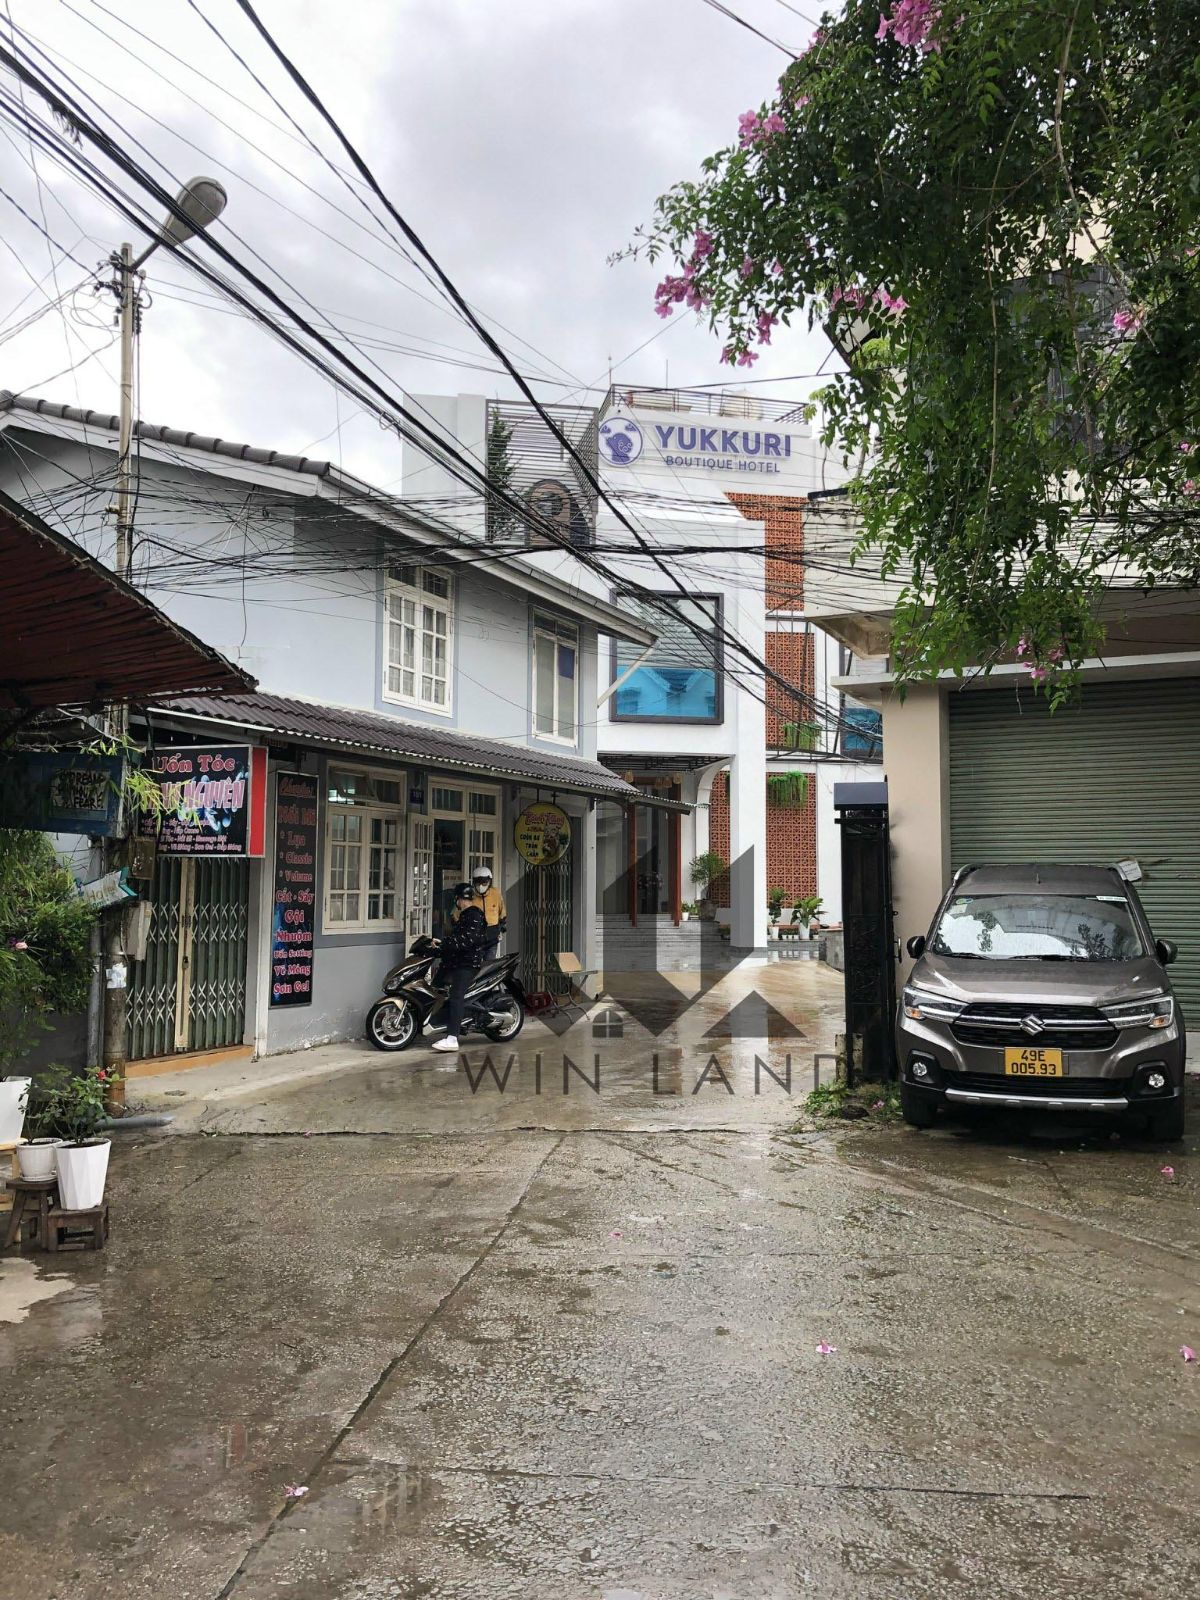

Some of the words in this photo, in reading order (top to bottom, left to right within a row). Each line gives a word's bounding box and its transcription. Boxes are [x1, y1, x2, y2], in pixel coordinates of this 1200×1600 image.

[655, 425, 791, 457] YUKKURI
[666, 455, 733, 470] BOUTIQUE
[738, 460, 781, 473] HOTEL
[197, 754, 235, 772] Tóc
[285, 851, 313, 865] Classic
[285, 870, 313, 883] Volume
[276, 887, 292, 903] Cắt
[284, 908, 305, 926] Gội
[275, 929, 312, 945] Nhuộm
[287, 963, 311, 977] Móng
[273, 983, 292, 995] Sơn
[294, 980, 310, 993] Gel
[1021, 1050, 1046, 1062] 49E
[1011, 1062, 1057, 1076] 005.93
